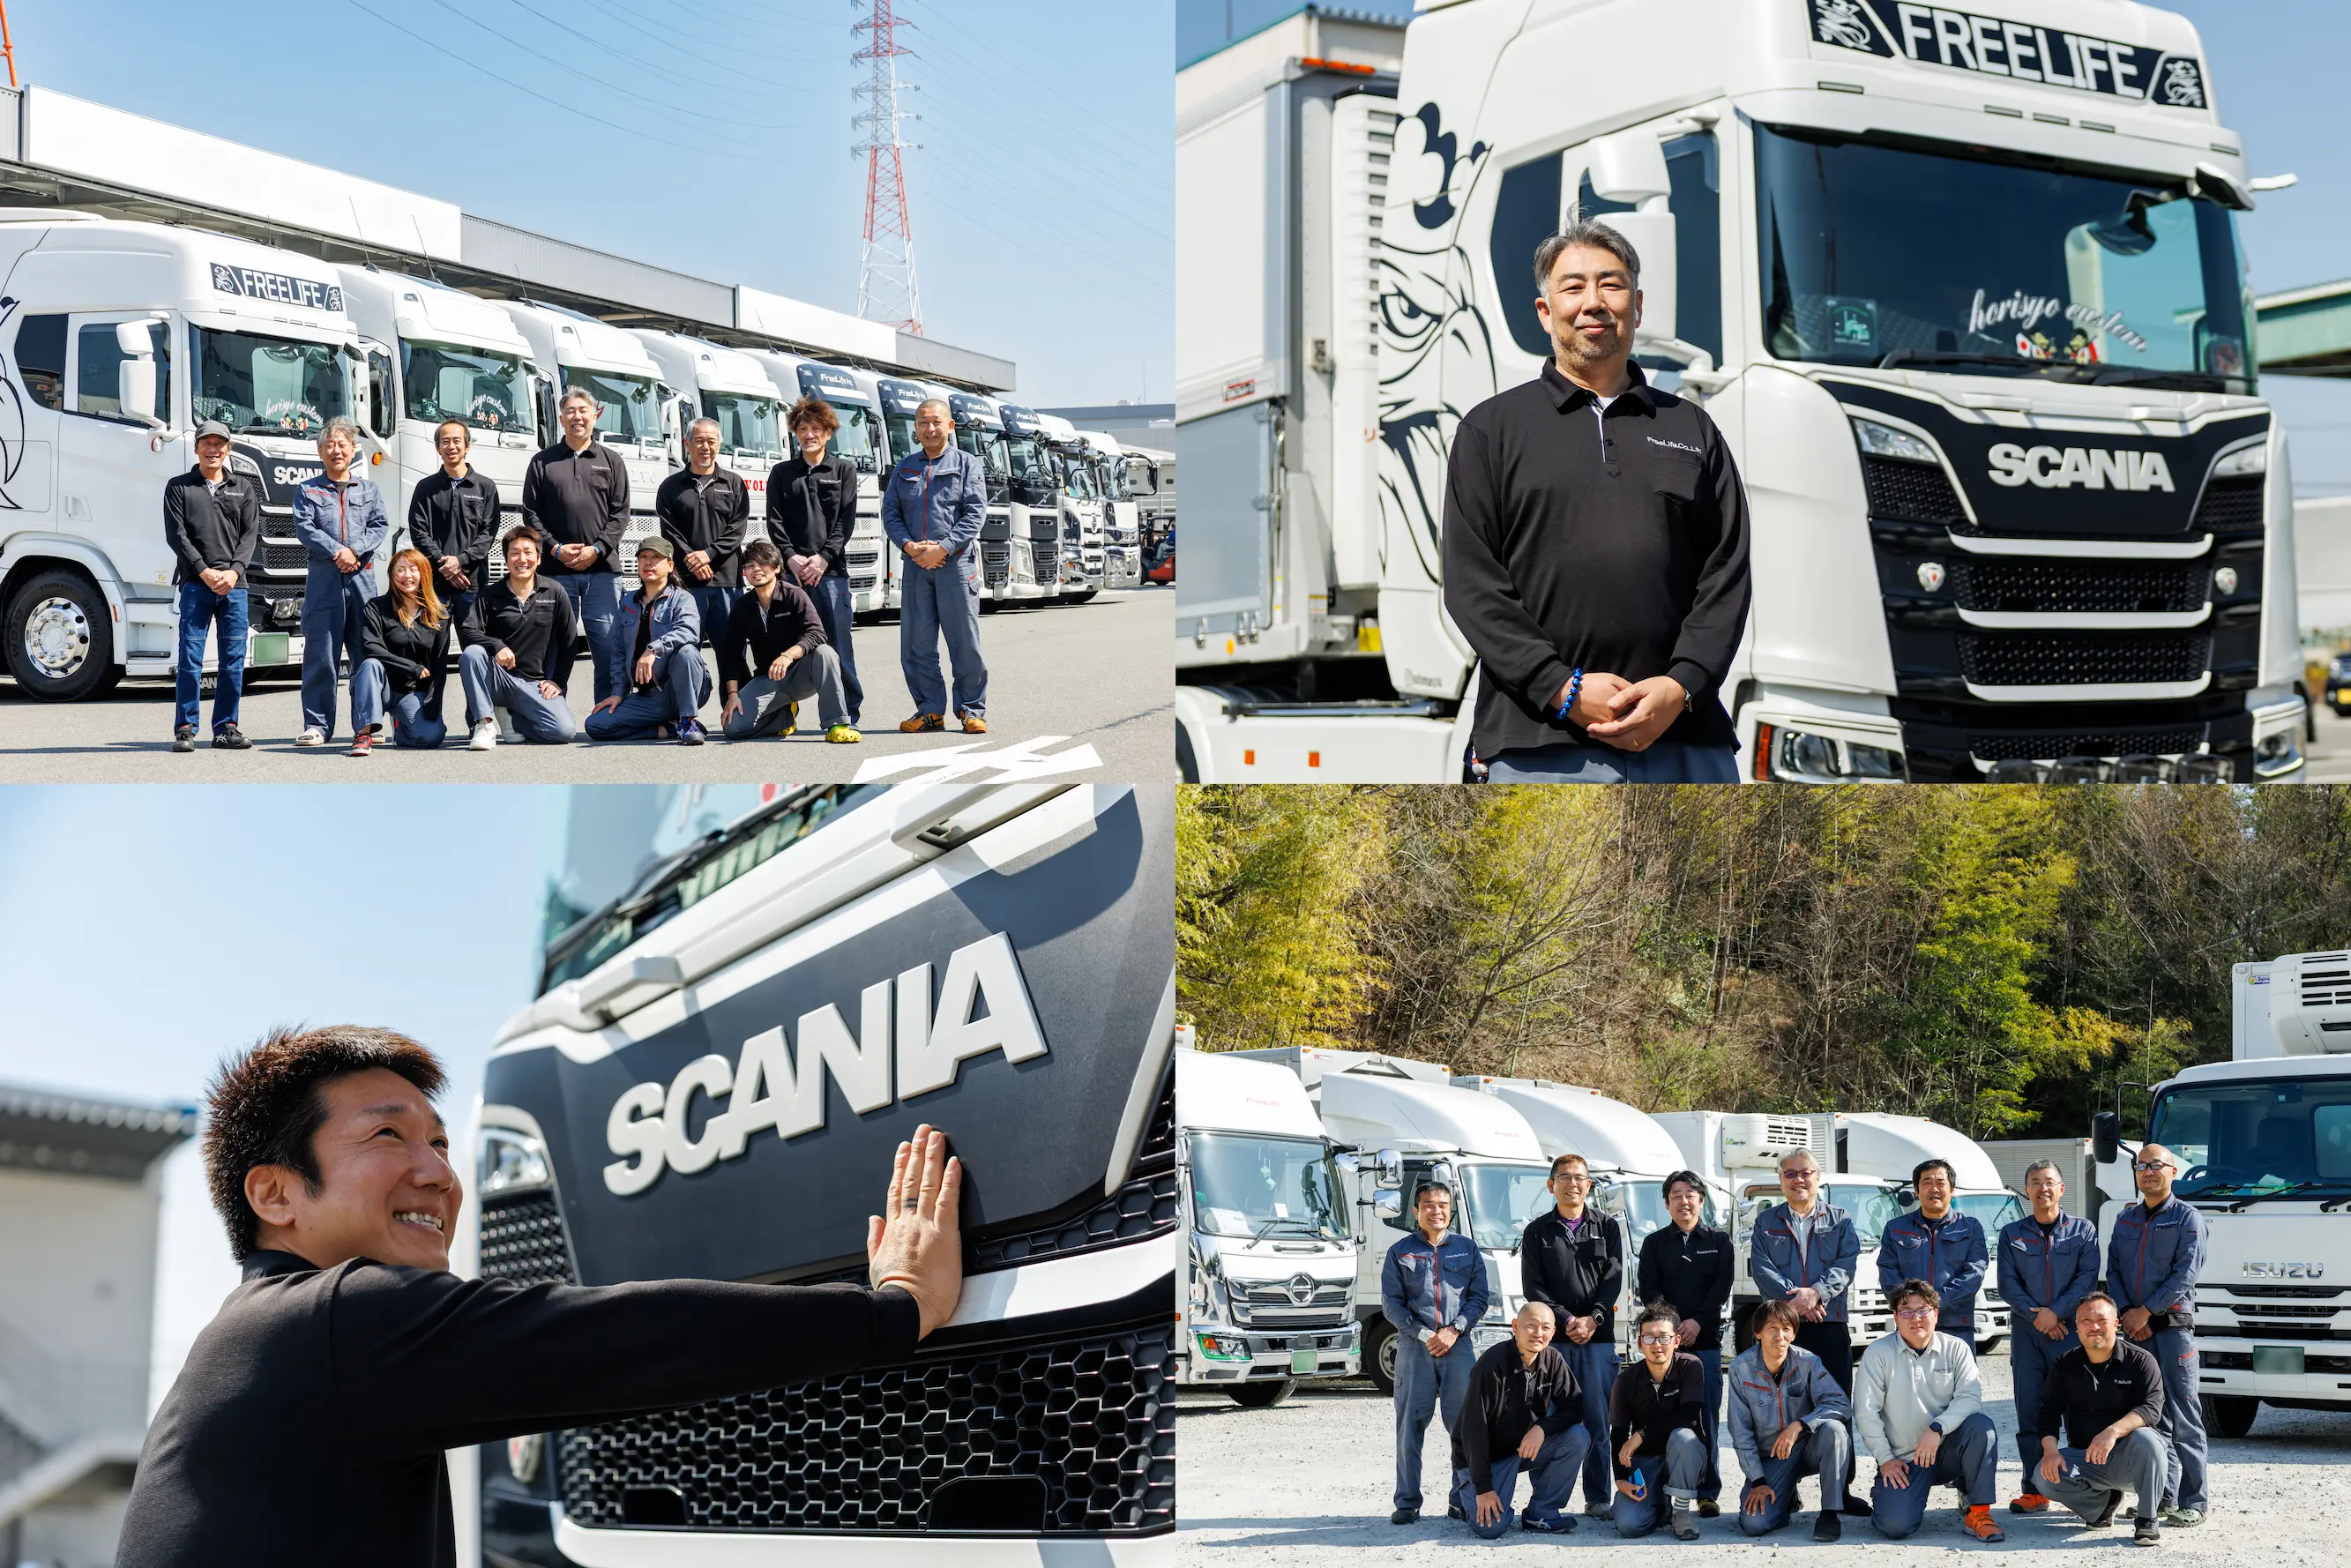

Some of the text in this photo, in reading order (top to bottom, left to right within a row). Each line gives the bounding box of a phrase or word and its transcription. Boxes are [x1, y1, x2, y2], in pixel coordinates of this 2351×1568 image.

[1897, 3, 2145, 100] FREELIFE
[241, 269, 324, 309] FREELIFE
[1968, 287, 2147, 352] horisyo custom
[265, 398, 325, 425] horisyo custom
[273, 466, 326, 485] SCAN
[744, 479, 768, 491] VOL
[1988, 443, 2176, 492] SCANIA
[602, 931, 1049, 1197] SCANIA
[2242, 1262, 2325, 1279] ISUZU
